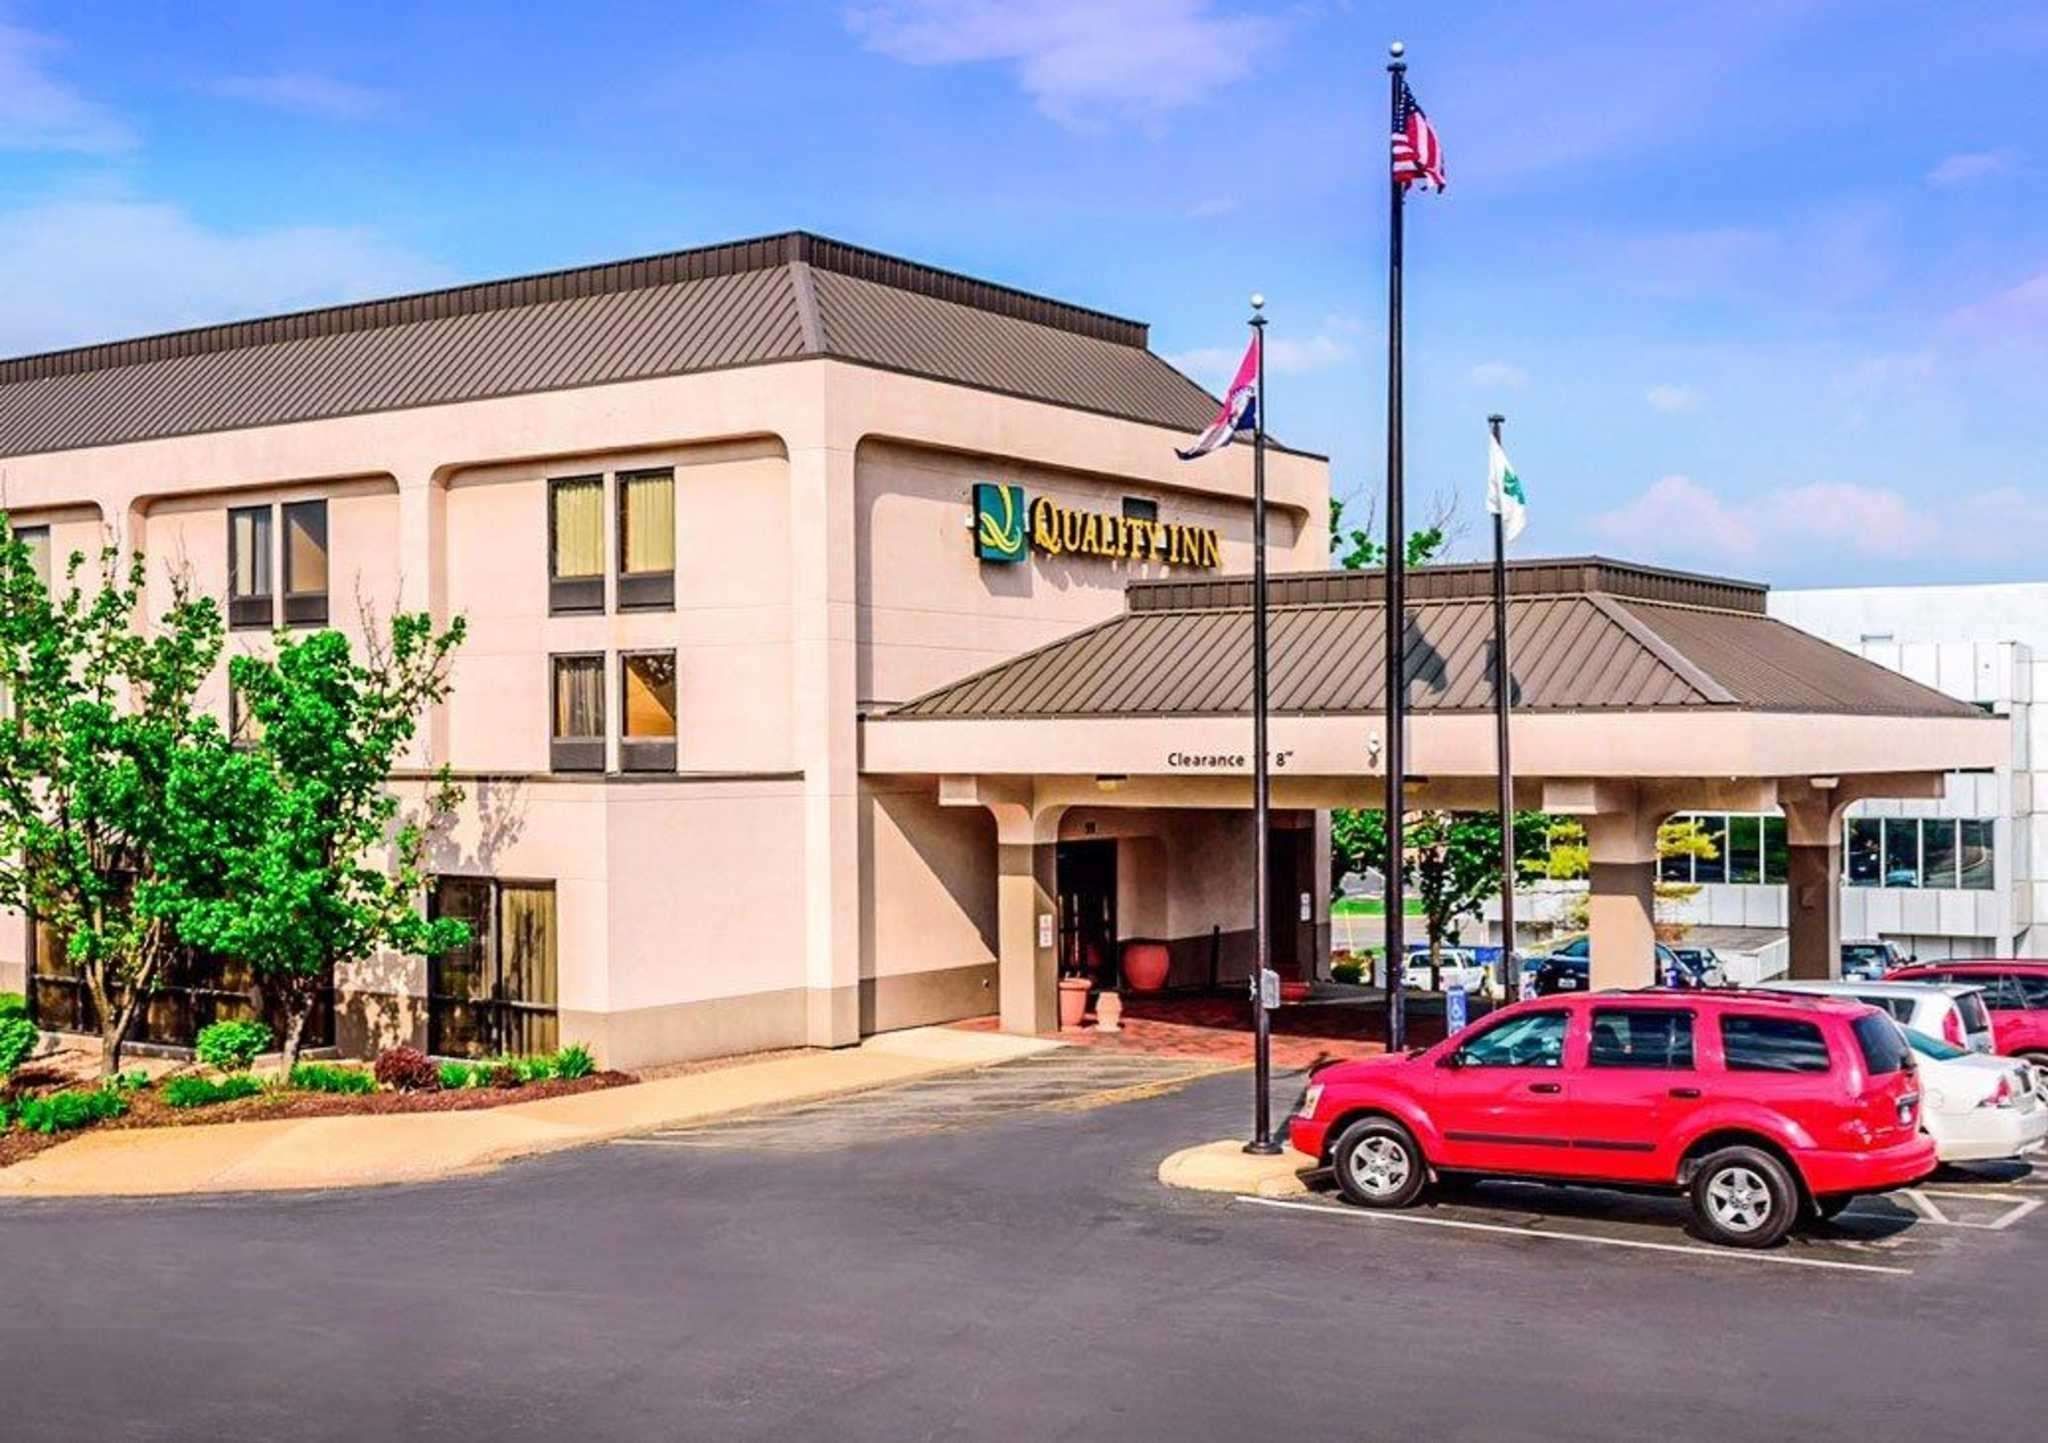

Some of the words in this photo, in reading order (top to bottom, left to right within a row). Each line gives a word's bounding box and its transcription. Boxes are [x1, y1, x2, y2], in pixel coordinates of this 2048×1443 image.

[1032, 496, 1164, 561] QUALITY
[1169, 523, 1222, 568] INN
[1167, 752, 1244, 767] Clearance
